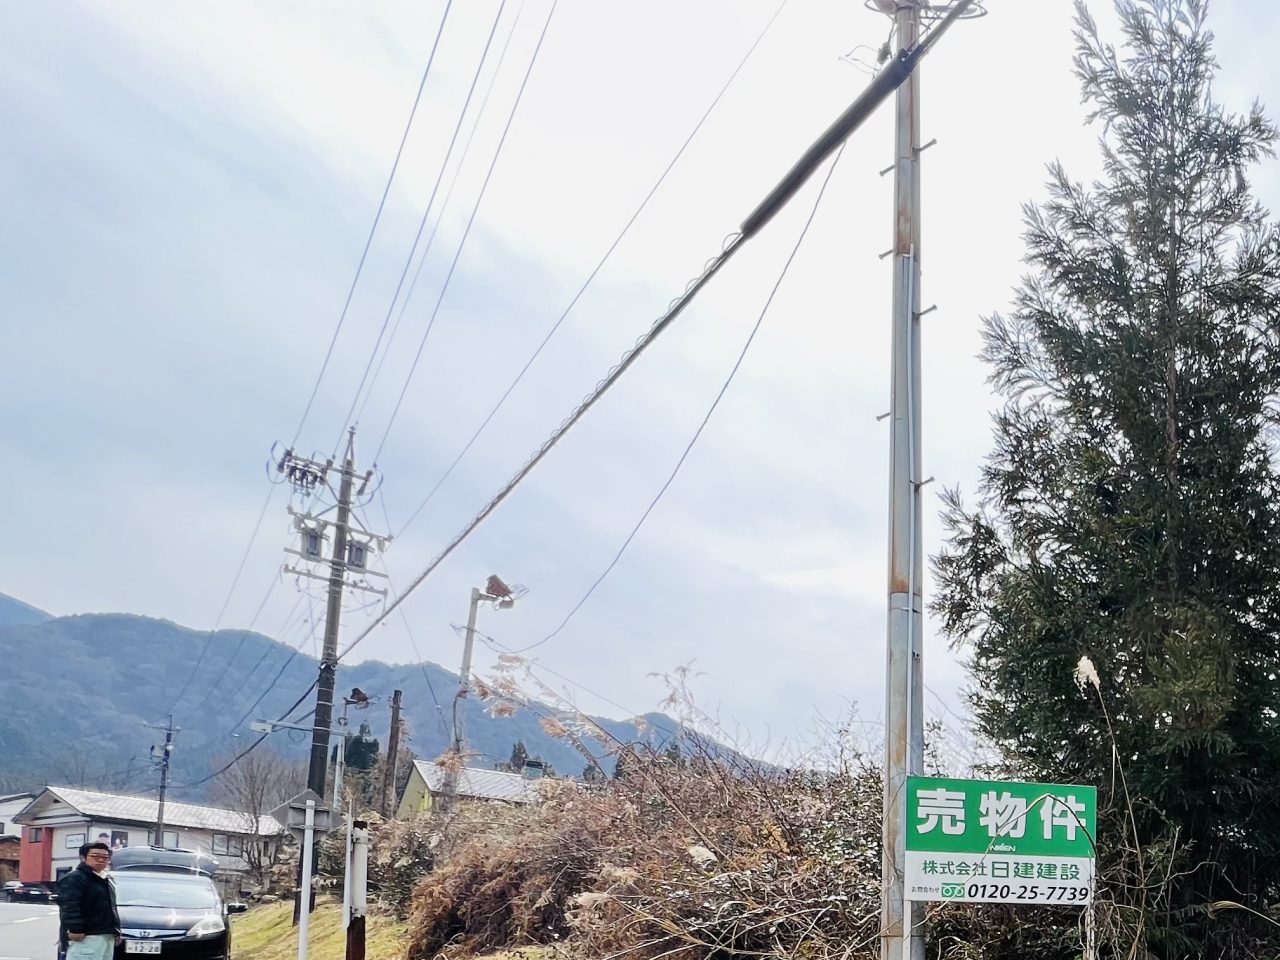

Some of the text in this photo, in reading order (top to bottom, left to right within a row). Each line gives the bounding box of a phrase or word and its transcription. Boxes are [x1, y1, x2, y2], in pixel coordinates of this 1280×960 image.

[916, 788, 1087, 841] 売物件
[922, 860, 1080, 880] 株式会社日建建設
[968, 883, 1089, 901] 0120-25-7739
